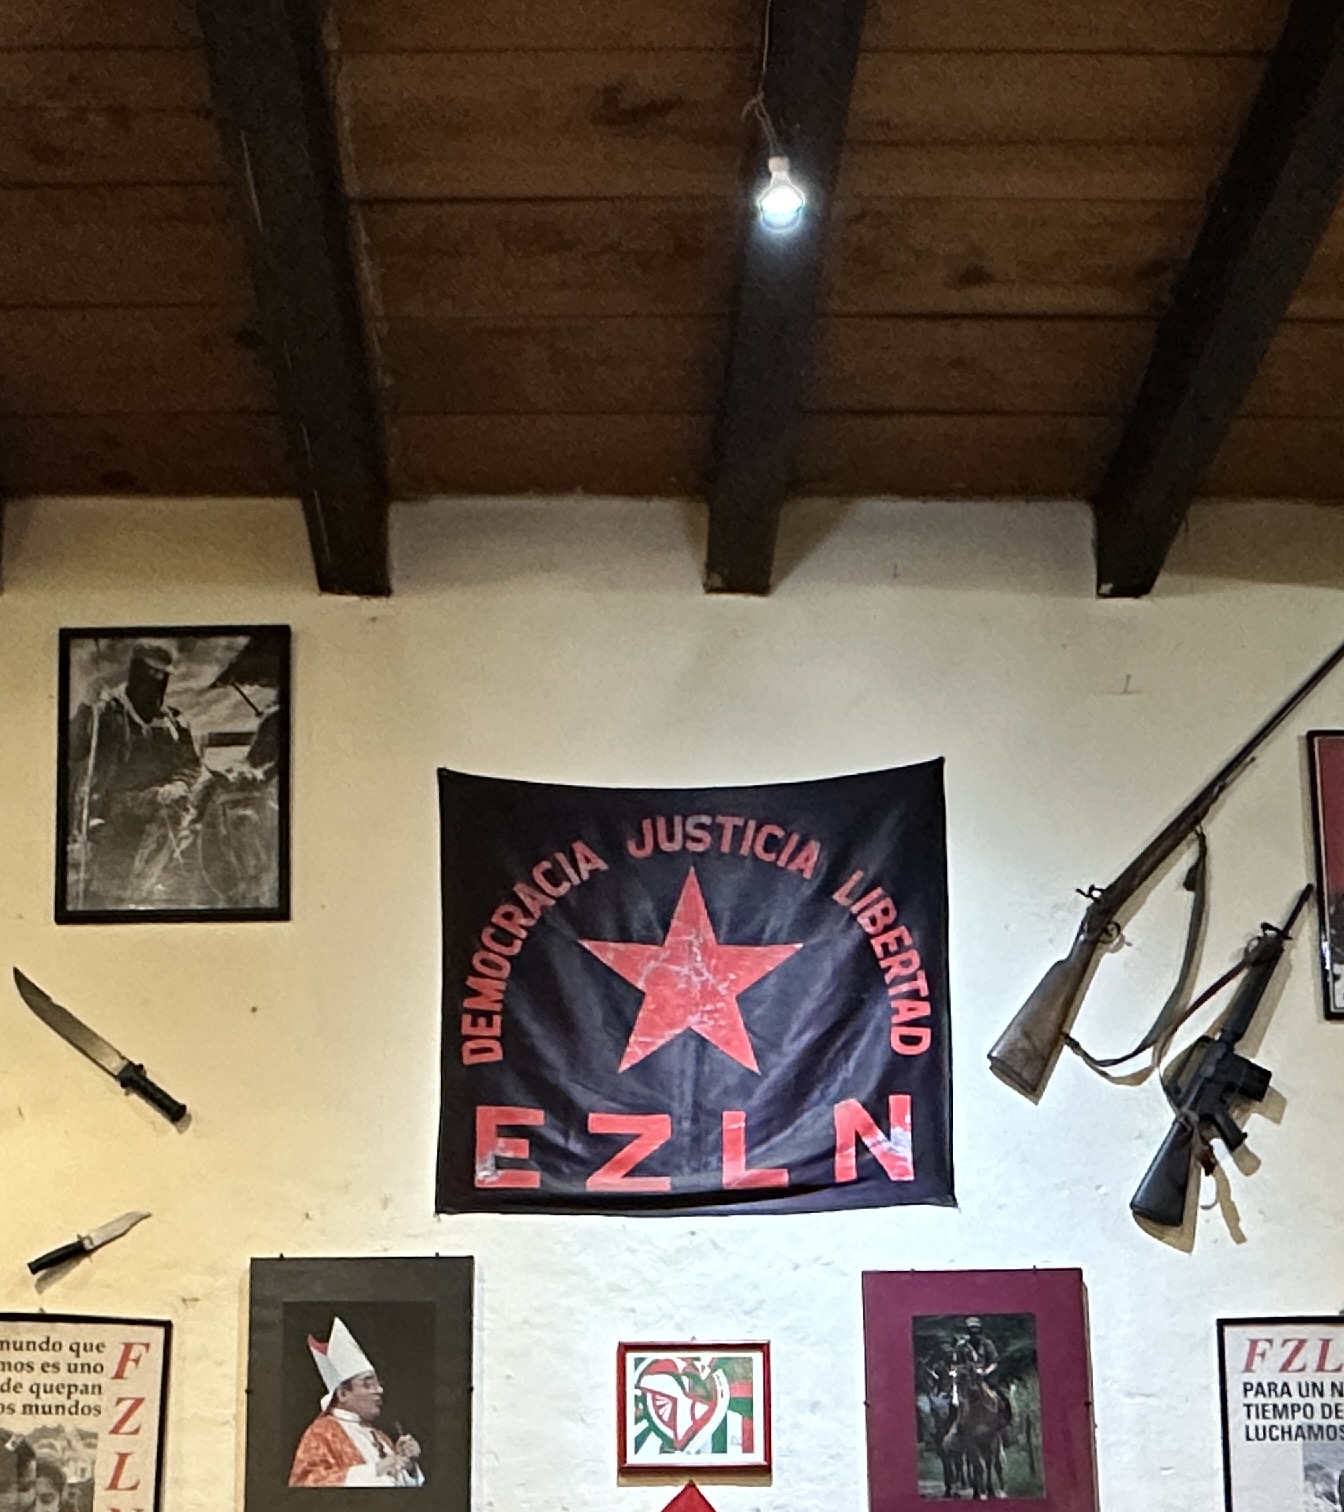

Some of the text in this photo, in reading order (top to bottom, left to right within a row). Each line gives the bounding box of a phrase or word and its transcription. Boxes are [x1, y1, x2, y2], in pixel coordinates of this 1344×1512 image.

[460, 813, 932, 1066] DEMOCRACIA JUSTICIA LIBERTAD
[68, 1339, 106, 1358] que
[40, 1361, 61, 1373] es
[66, 1362, 104, 1374] uno
[28, 1381, 103, 1399] quepan
[1243, 1381, 1292, 1398] PARA
[1298, 1381, 1324, 1398] UN
[20, 1400, 102, 1417] mundos
[1243, 1403, 1314, 1420] TIEMPO
[1321, 1403, 1344, 1420] DE
